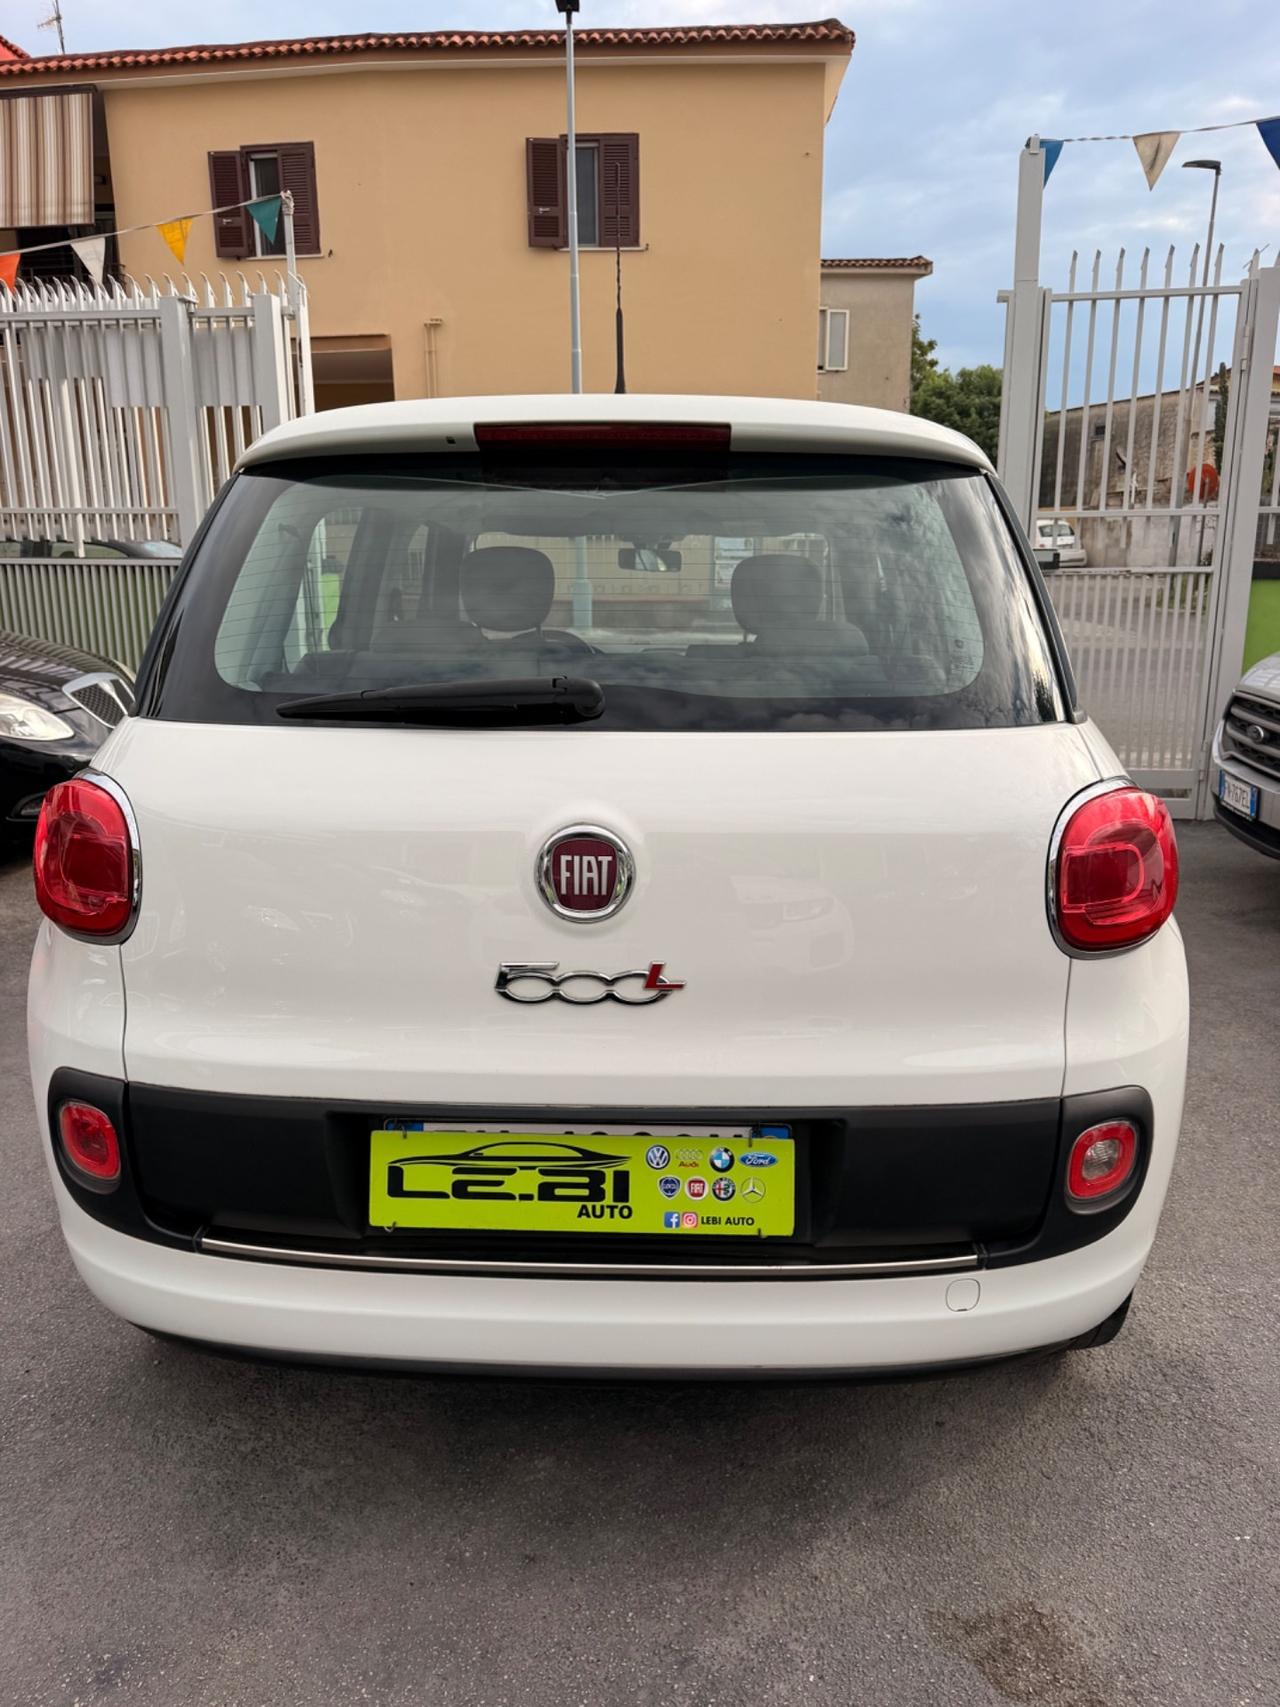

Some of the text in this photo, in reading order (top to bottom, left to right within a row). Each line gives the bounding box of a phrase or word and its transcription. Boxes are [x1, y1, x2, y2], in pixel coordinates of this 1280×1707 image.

[560, 855, 613, 896] FIAT
[495, 961, 687, 1006] 500L
[577, 1204, 633, 1219] AUTO
[701, 1216, 755, 1226] LEBI AUTO
